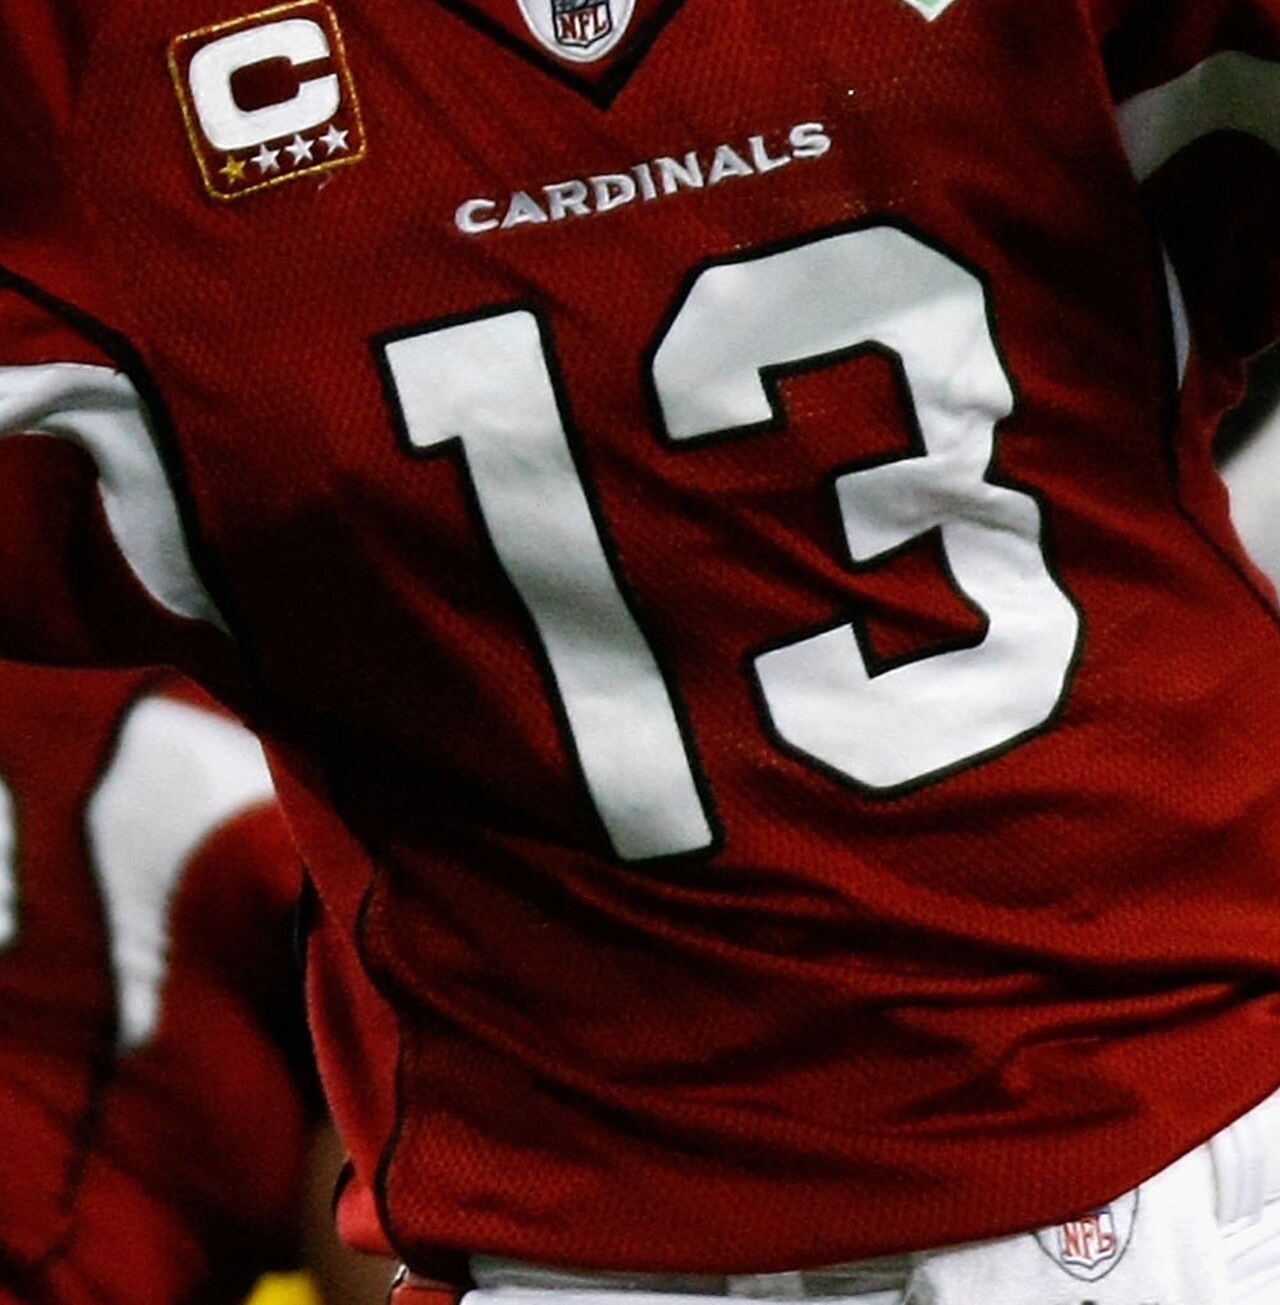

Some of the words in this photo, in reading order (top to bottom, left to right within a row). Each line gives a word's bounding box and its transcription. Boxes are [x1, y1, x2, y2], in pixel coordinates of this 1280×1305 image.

[187, 17, 340, 152] C
[556, 4, 610, 42] NFL
[454, 122, 832, 235] CARDINALS
[377, 218, 1086, 864] 13
